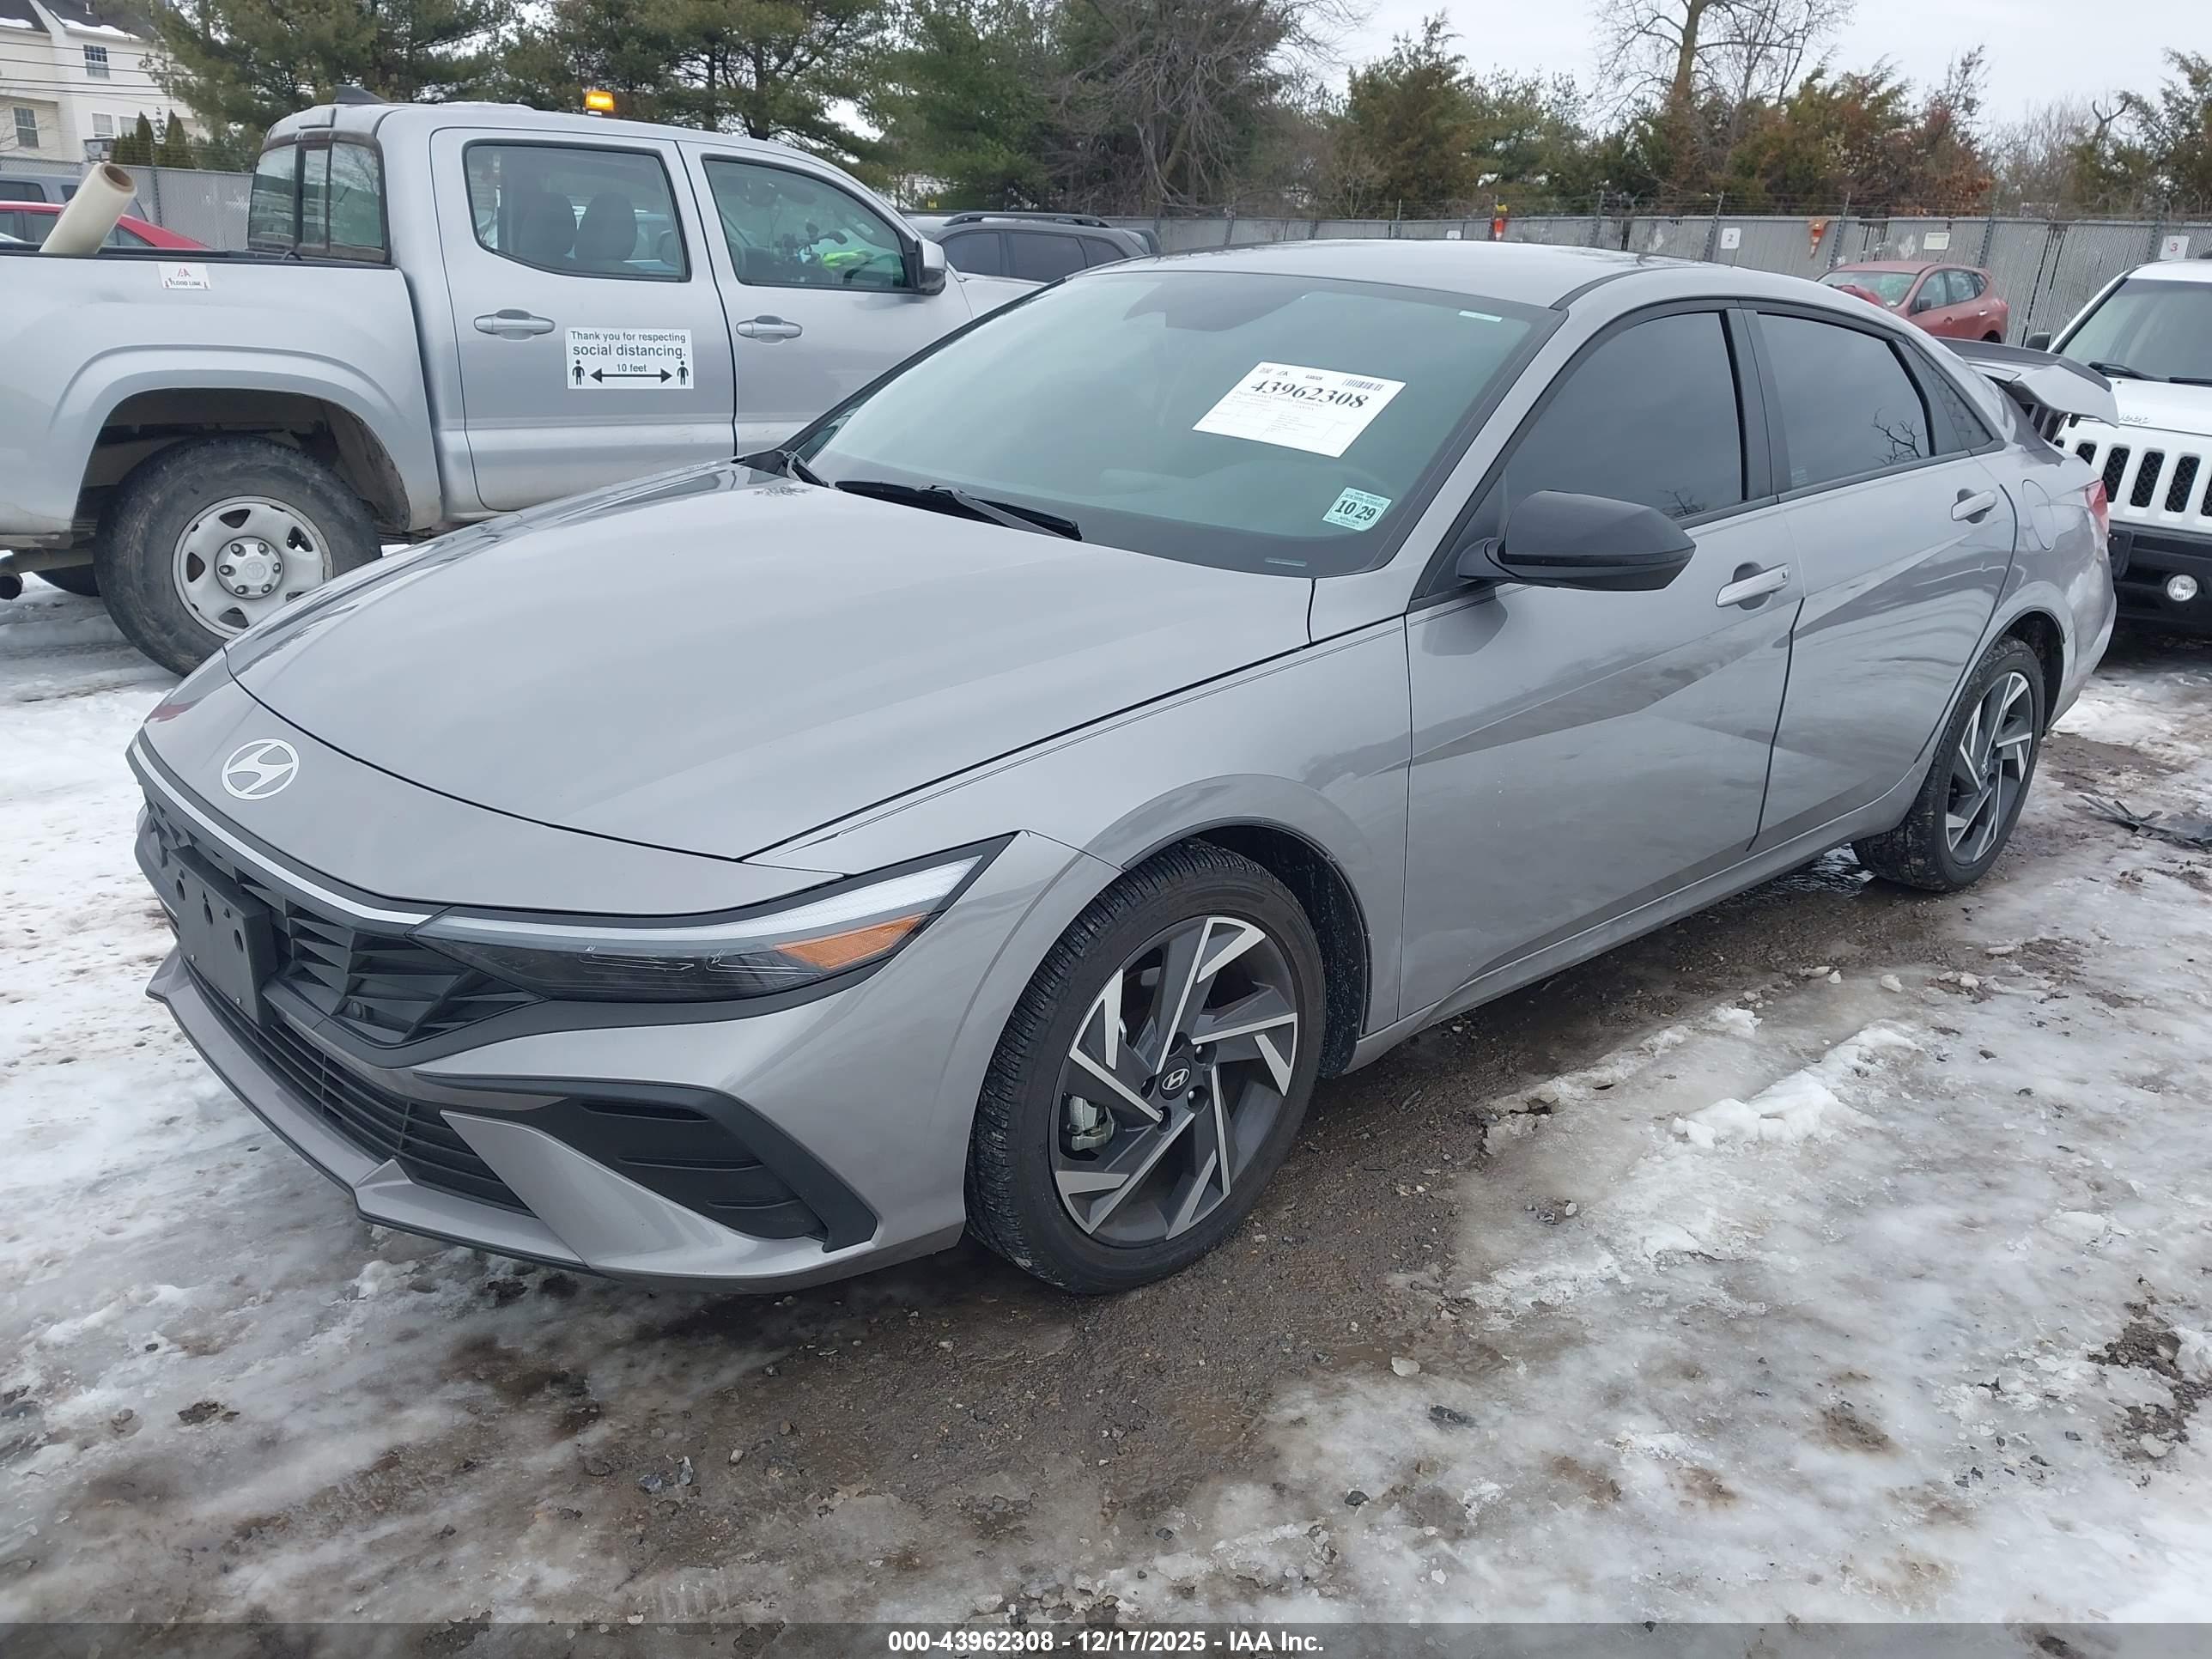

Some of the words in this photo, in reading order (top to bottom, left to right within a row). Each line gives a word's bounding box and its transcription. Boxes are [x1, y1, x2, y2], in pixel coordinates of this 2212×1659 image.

[2170, 242, 2179, 252] 3
[570, 331, 600, 341] Thank
[603, 332, 620, 343] you
[623, 331, 635, 341] for
[638, 332, 686, 343] respecting
[573, 343, 612, 356] social
[616, 343, 686, 360] distancing.
[617, 363, 627, 373] 10
[629, 363, 647, 373] feet
[1250, 380, 1369, 408] 43962308
[1334, 500, 1357, 514] 10
[1354, 505, 1376, 521] 29
